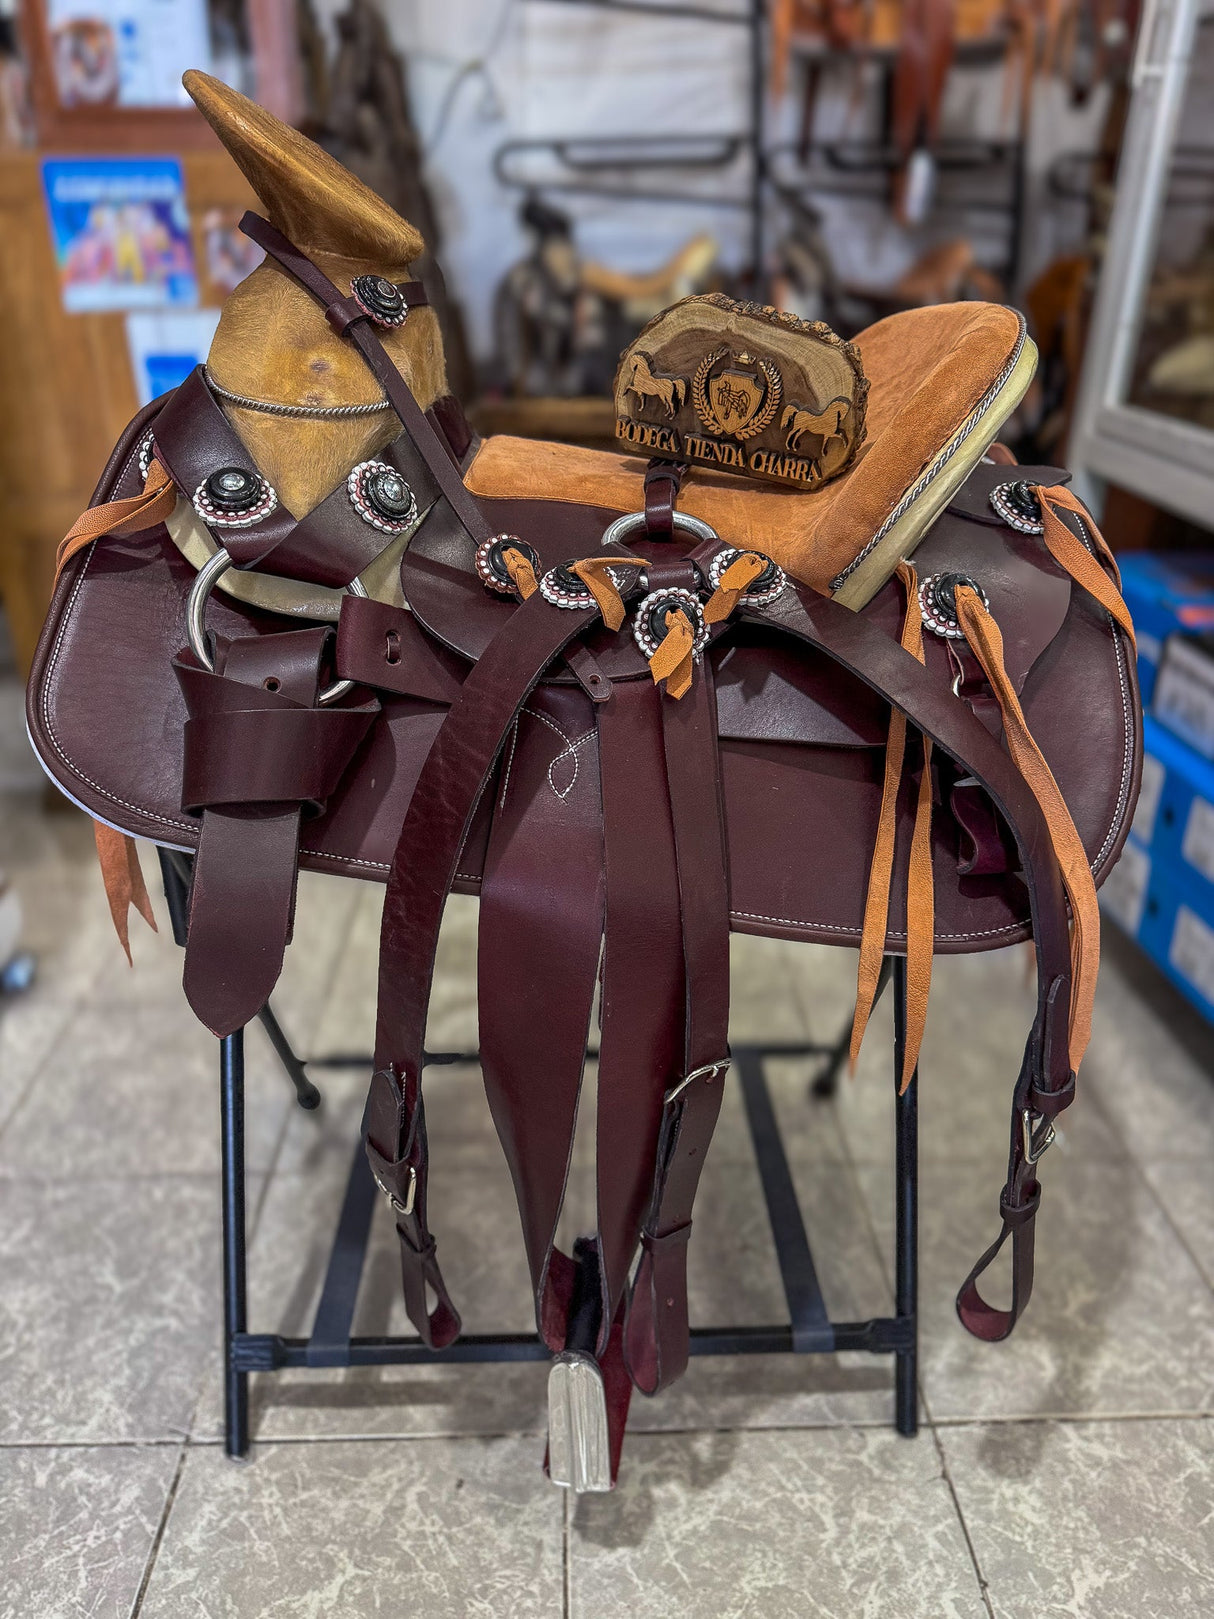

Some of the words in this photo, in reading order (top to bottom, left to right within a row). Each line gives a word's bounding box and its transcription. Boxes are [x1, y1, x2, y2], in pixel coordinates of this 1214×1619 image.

[615, 418, 677, 452] BODEGA
[684, 435, 745, 468] TIENDA
[750, 452, 821, 482] CHARRA
